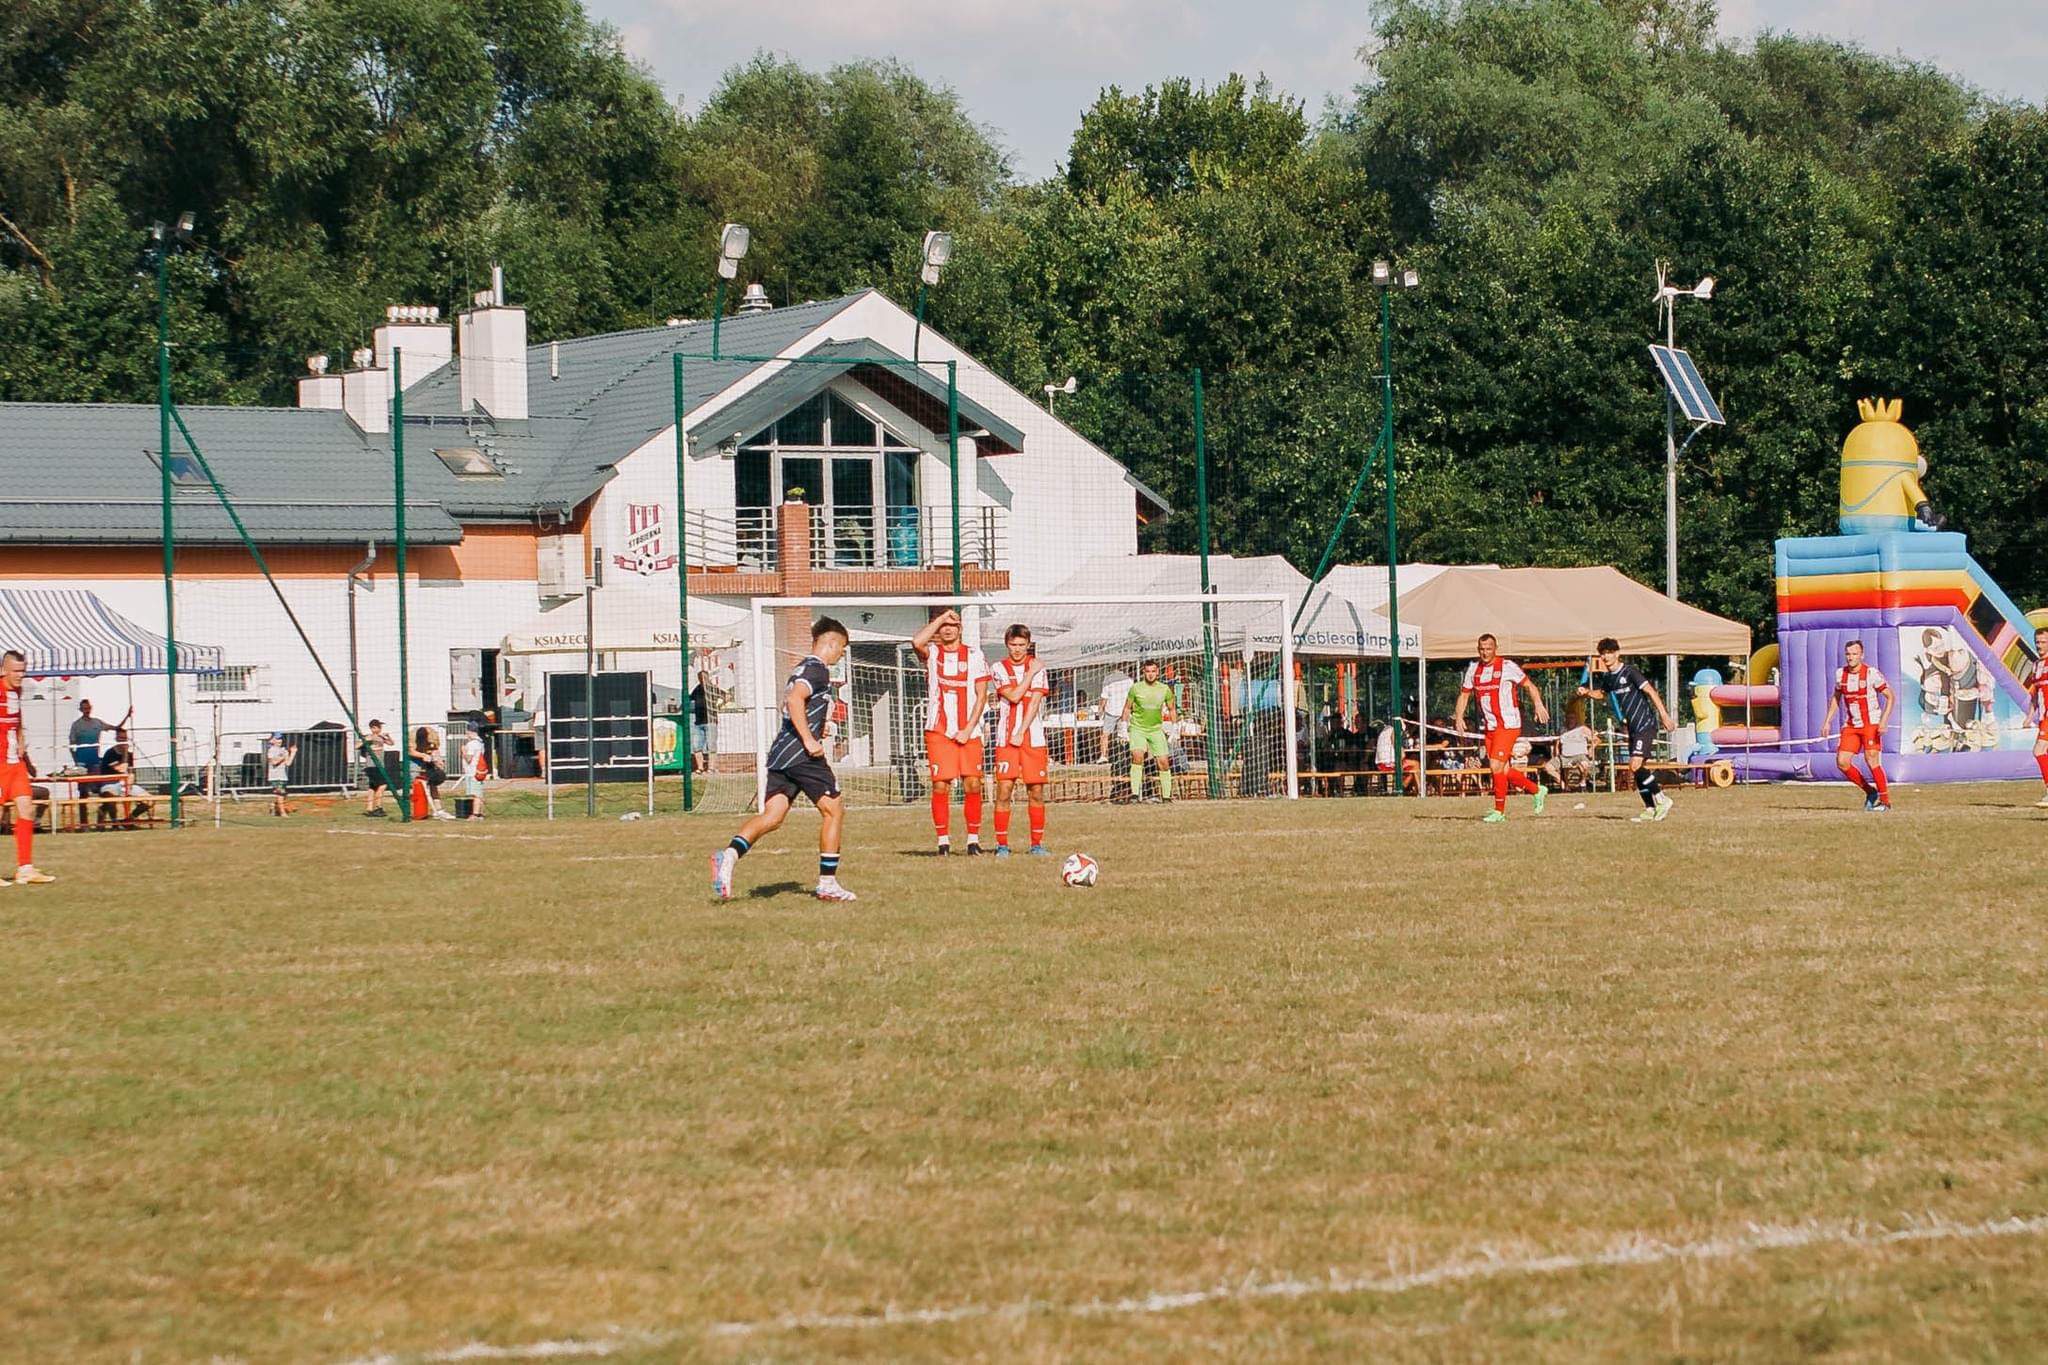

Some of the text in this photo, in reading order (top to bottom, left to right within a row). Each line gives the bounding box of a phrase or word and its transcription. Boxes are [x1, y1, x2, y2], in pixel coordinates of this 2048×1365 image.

[653, 633, 708, 645] KSIĄĘCE
[1252, 631, 1419, 651] wwwmeblesabinpl.pl
[1636, 739, 1643, 751] 9
